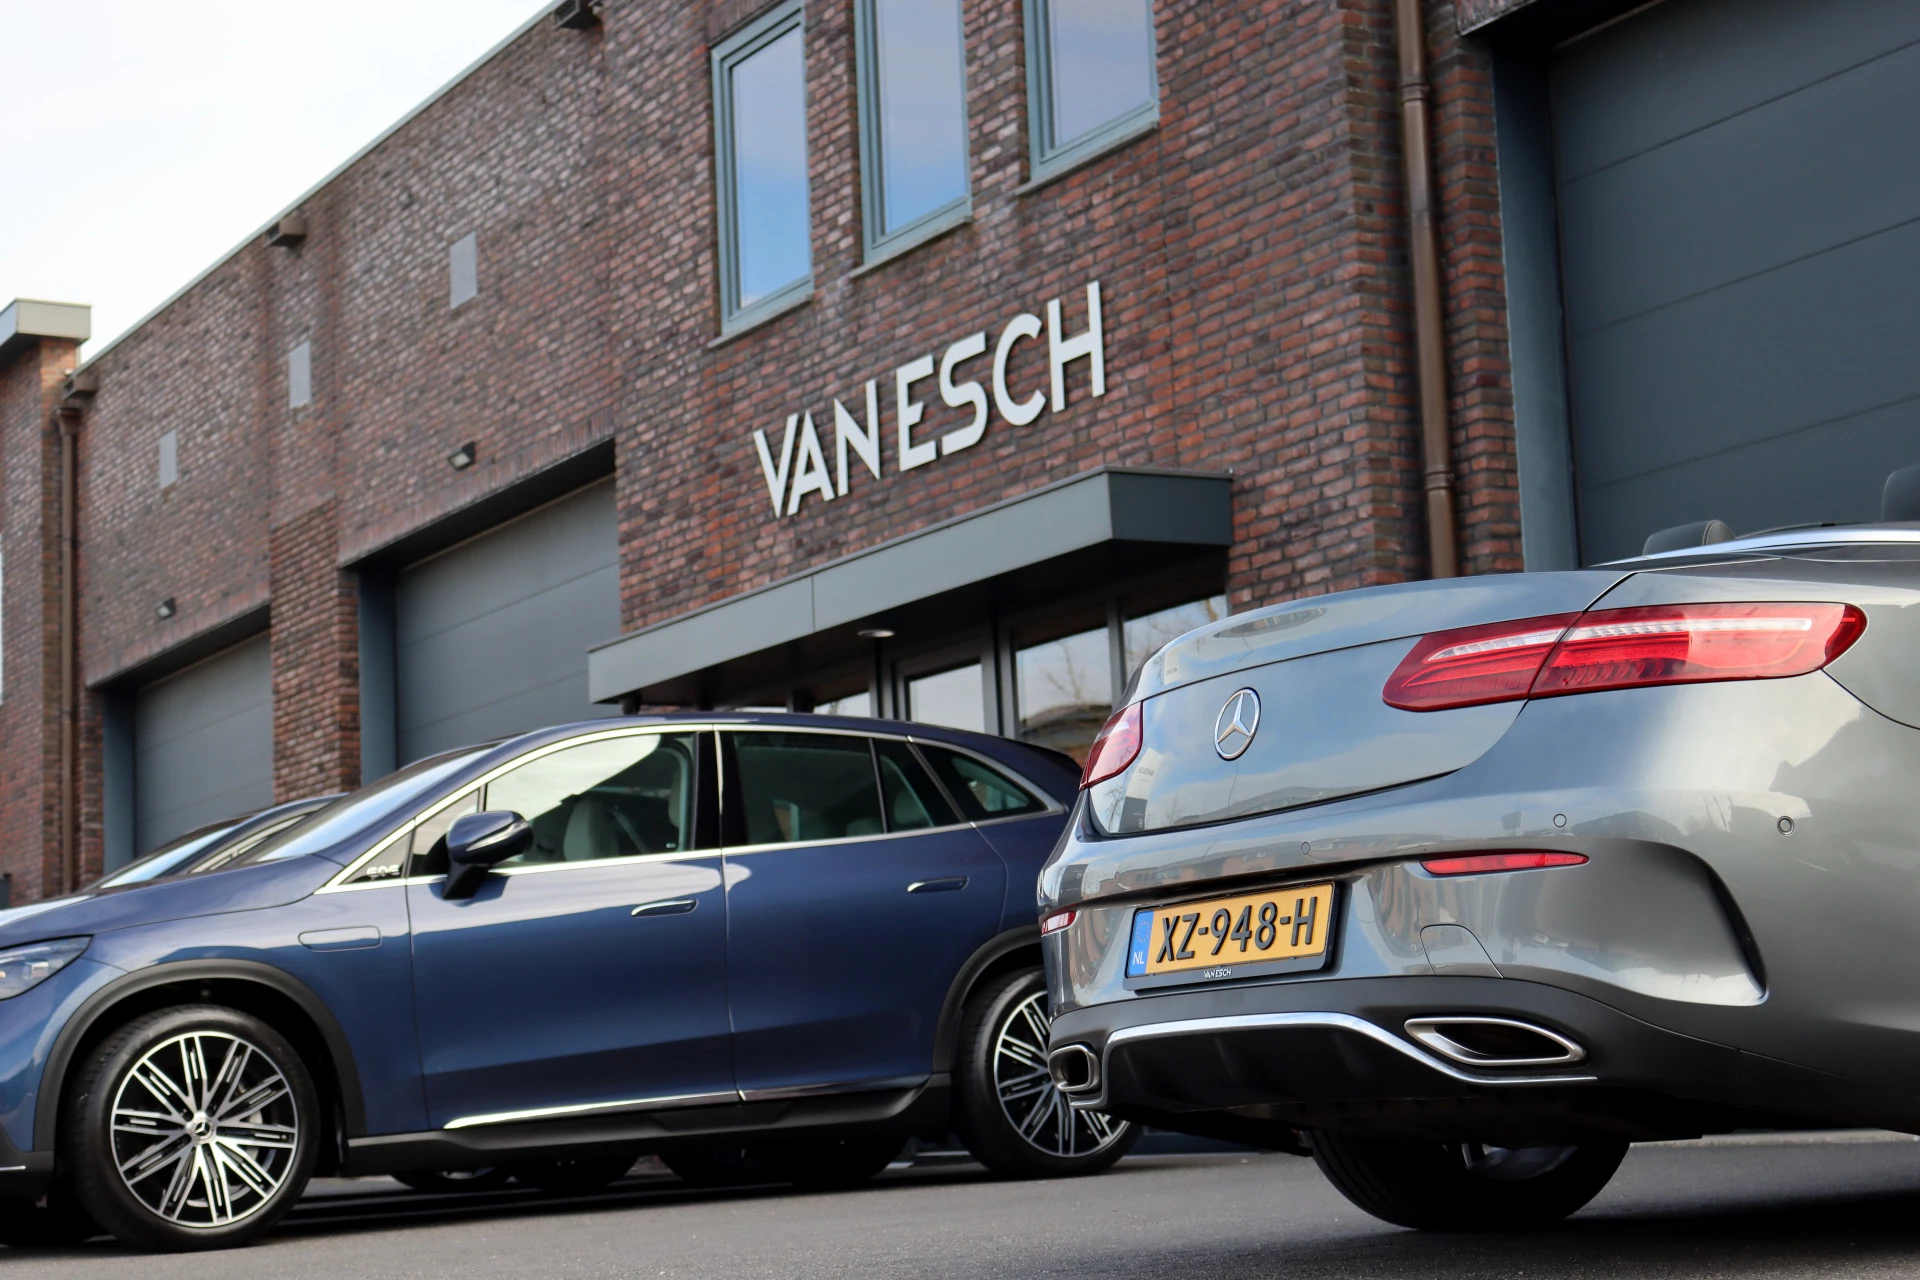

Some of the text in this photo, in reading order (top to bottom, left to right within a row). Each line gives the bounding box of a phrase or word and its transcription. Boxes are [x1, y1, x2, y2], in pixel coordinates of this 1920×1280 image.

[753, 280, 1105, 519] VAN ESCH
[1132, 951, 1145, 966] NL
[1156, 896, 1318, 963] XZ-948-H
